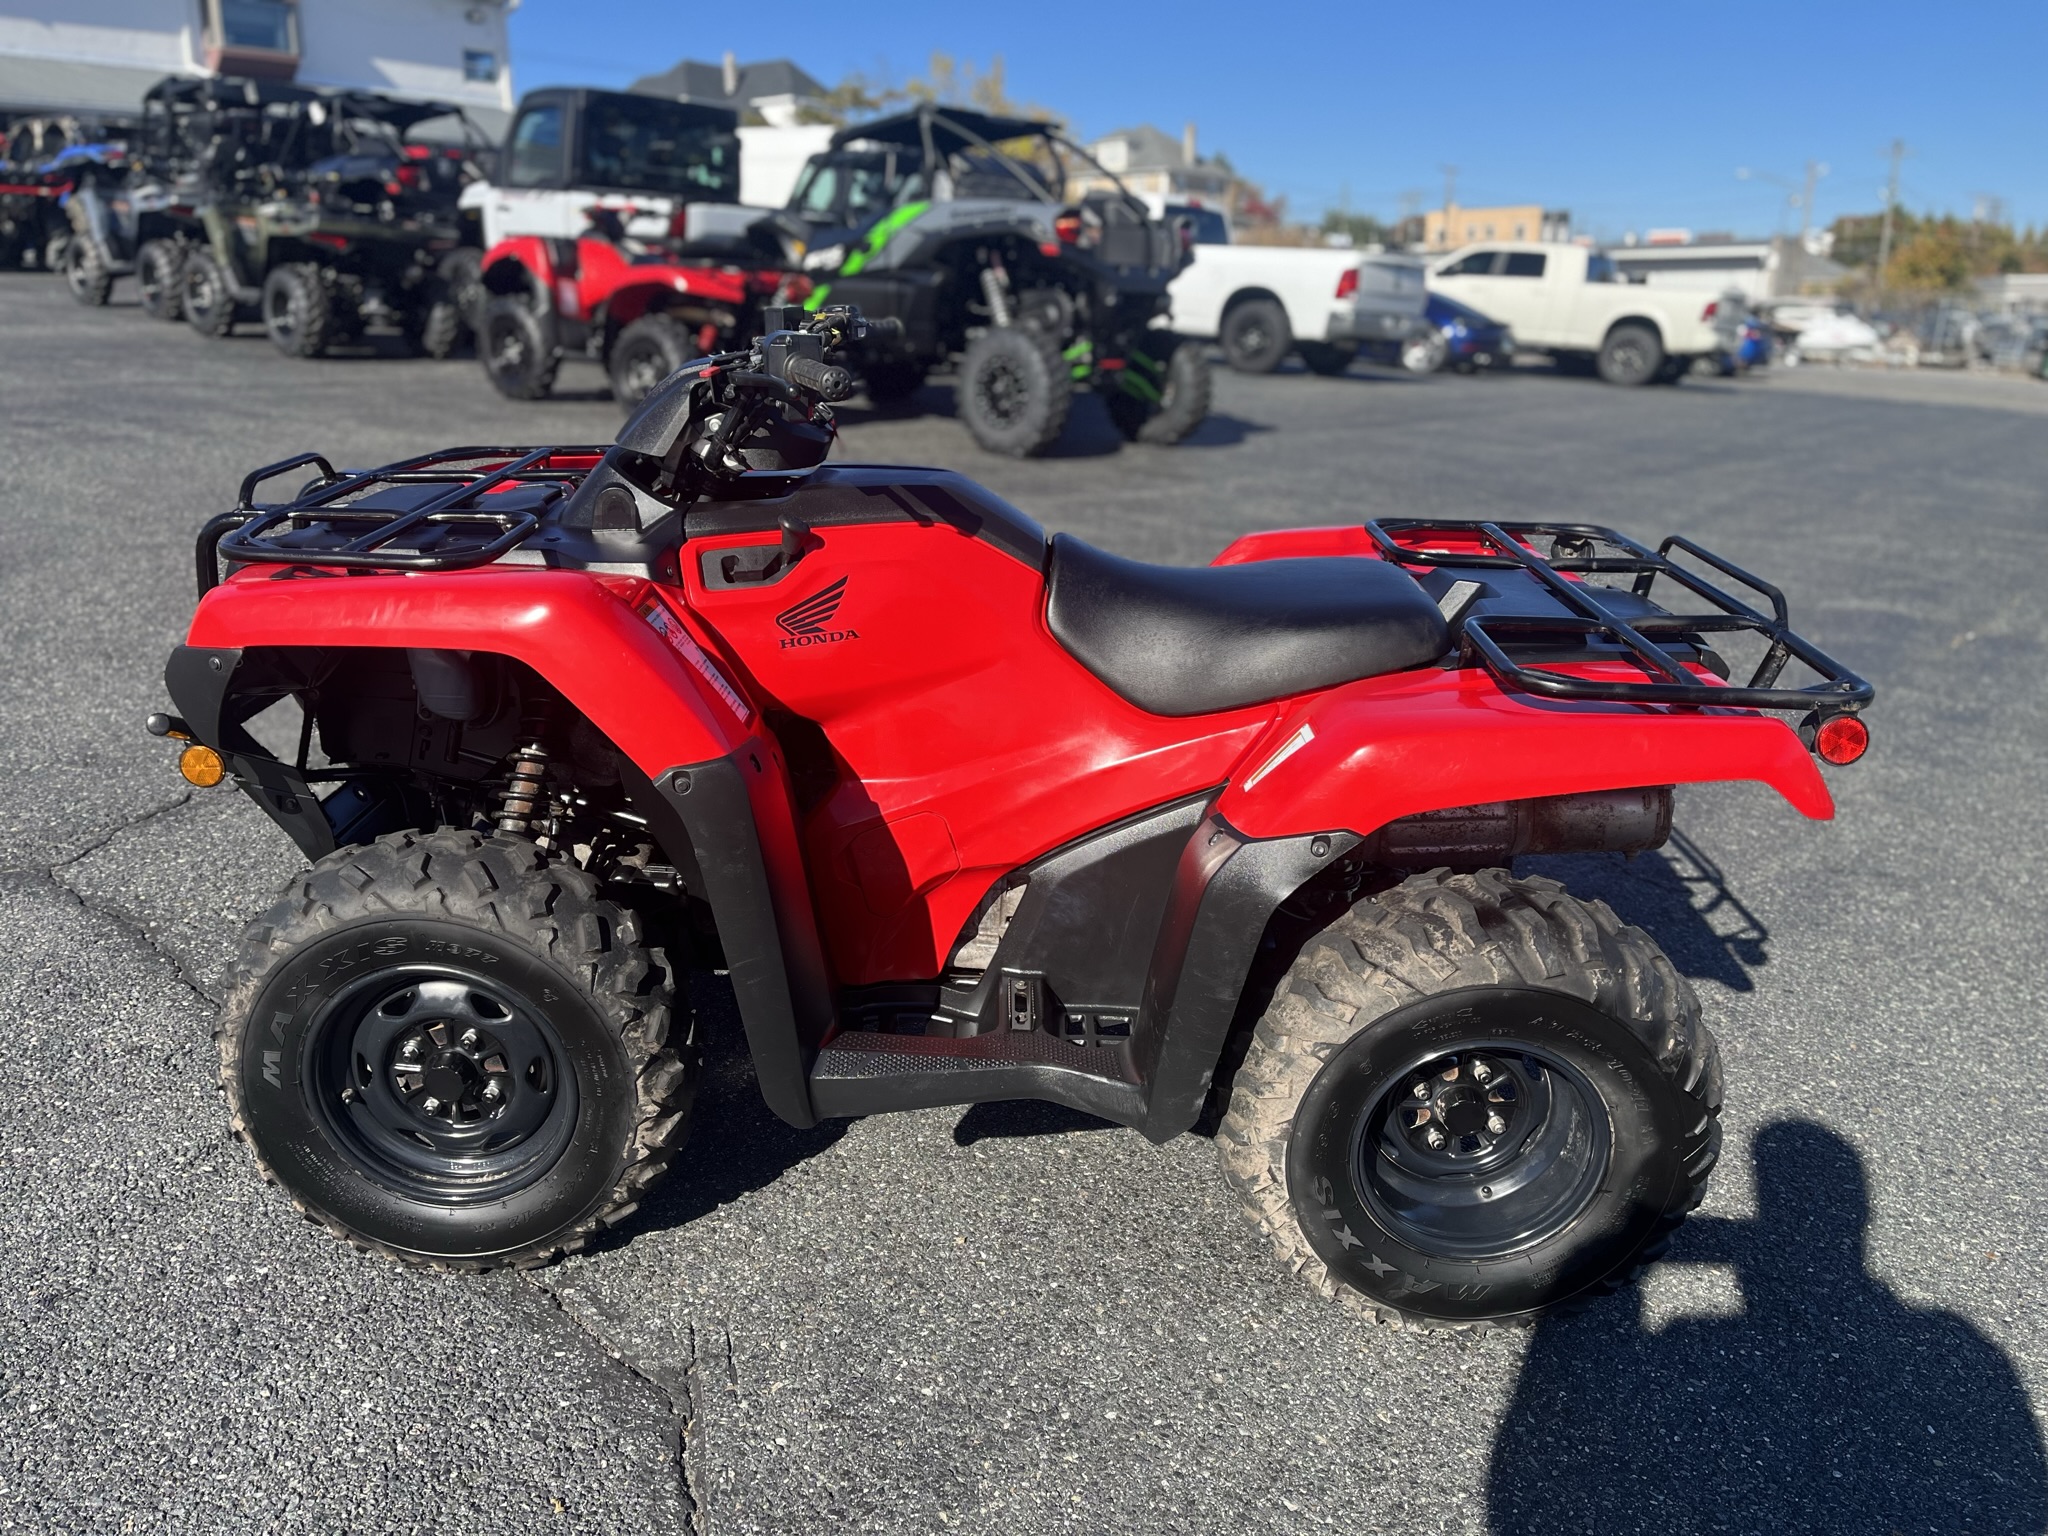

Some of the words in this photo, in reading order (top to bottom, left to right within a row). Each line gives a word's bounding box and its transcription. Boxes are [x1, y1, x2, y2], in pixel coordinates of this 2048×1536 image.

[779, 630, 861, 650] HONDA
[260, 935, 409, 1091] MAXXIS
[1311, 1175, 1494, 1301] MAXXIS
